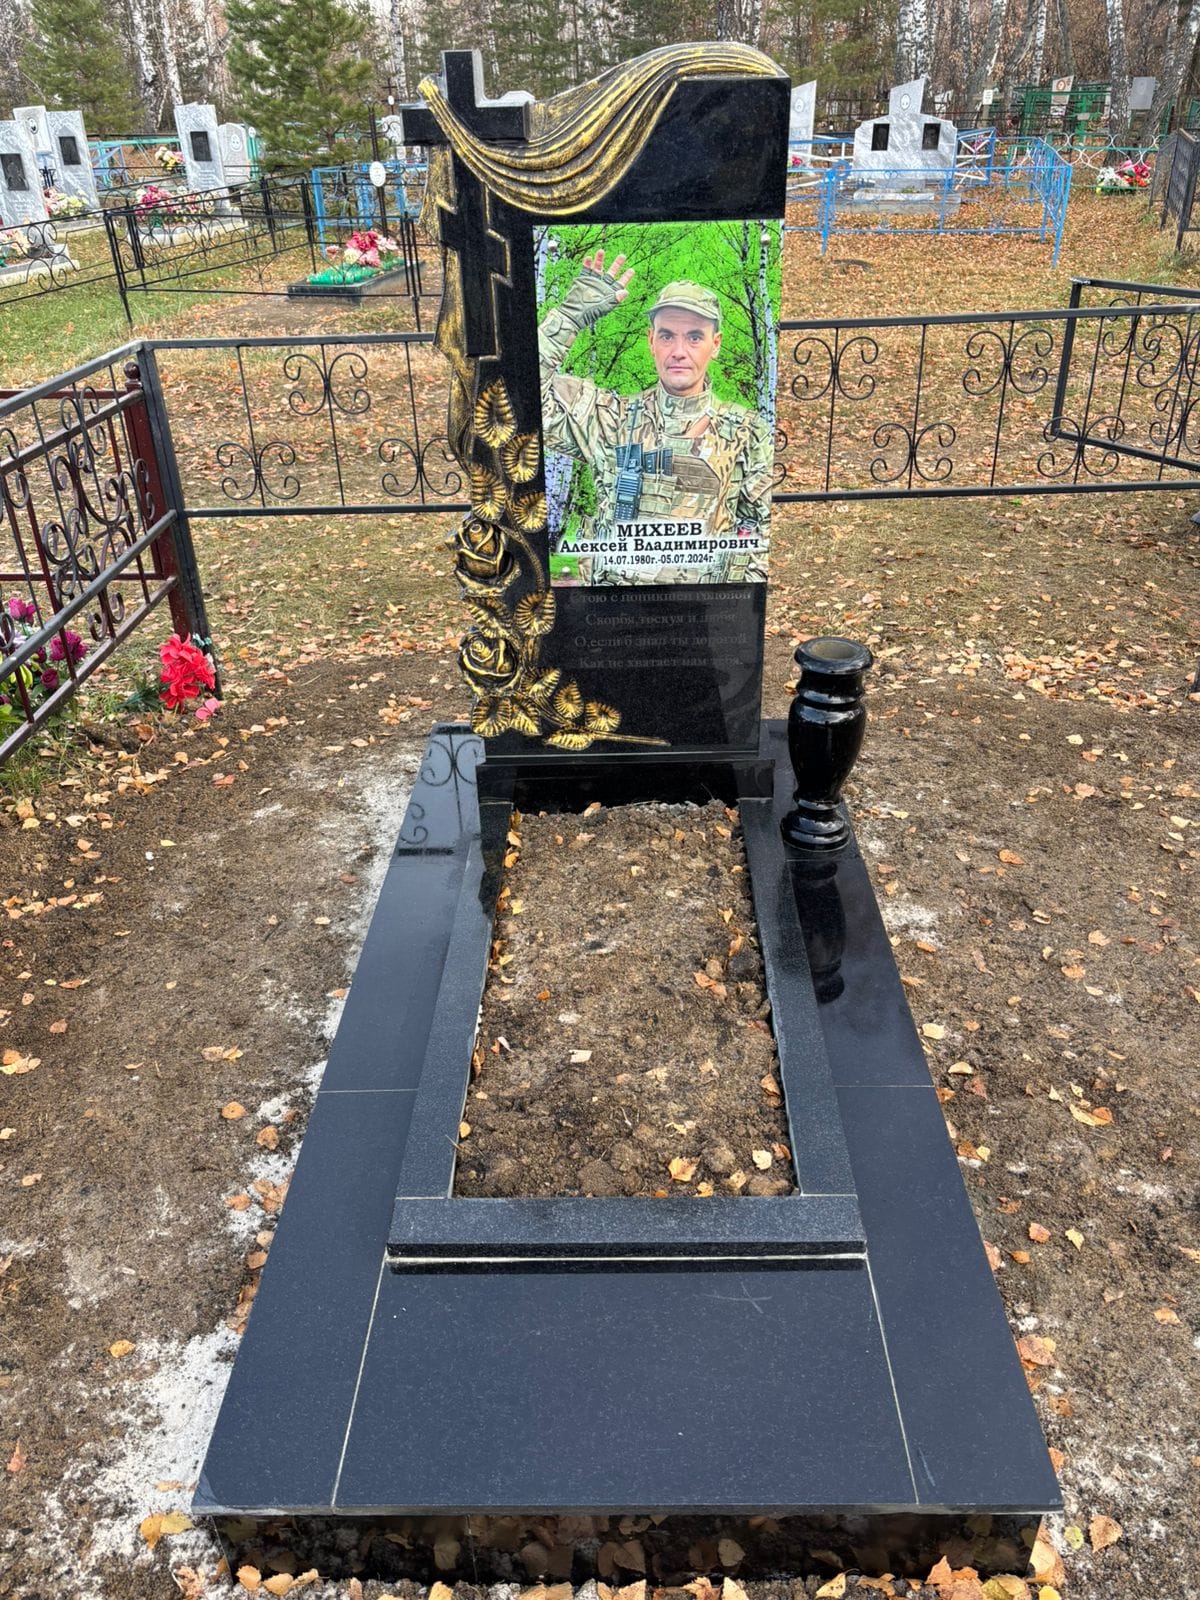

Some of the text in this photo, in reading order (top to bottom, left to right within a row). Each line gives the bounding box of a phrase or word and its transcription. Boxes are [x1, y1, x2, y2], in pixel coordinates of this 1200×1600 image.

[617, 522, 702, 537] МИХЕЕВ
[560, 538, 759, 553] Алексей Владимирович
